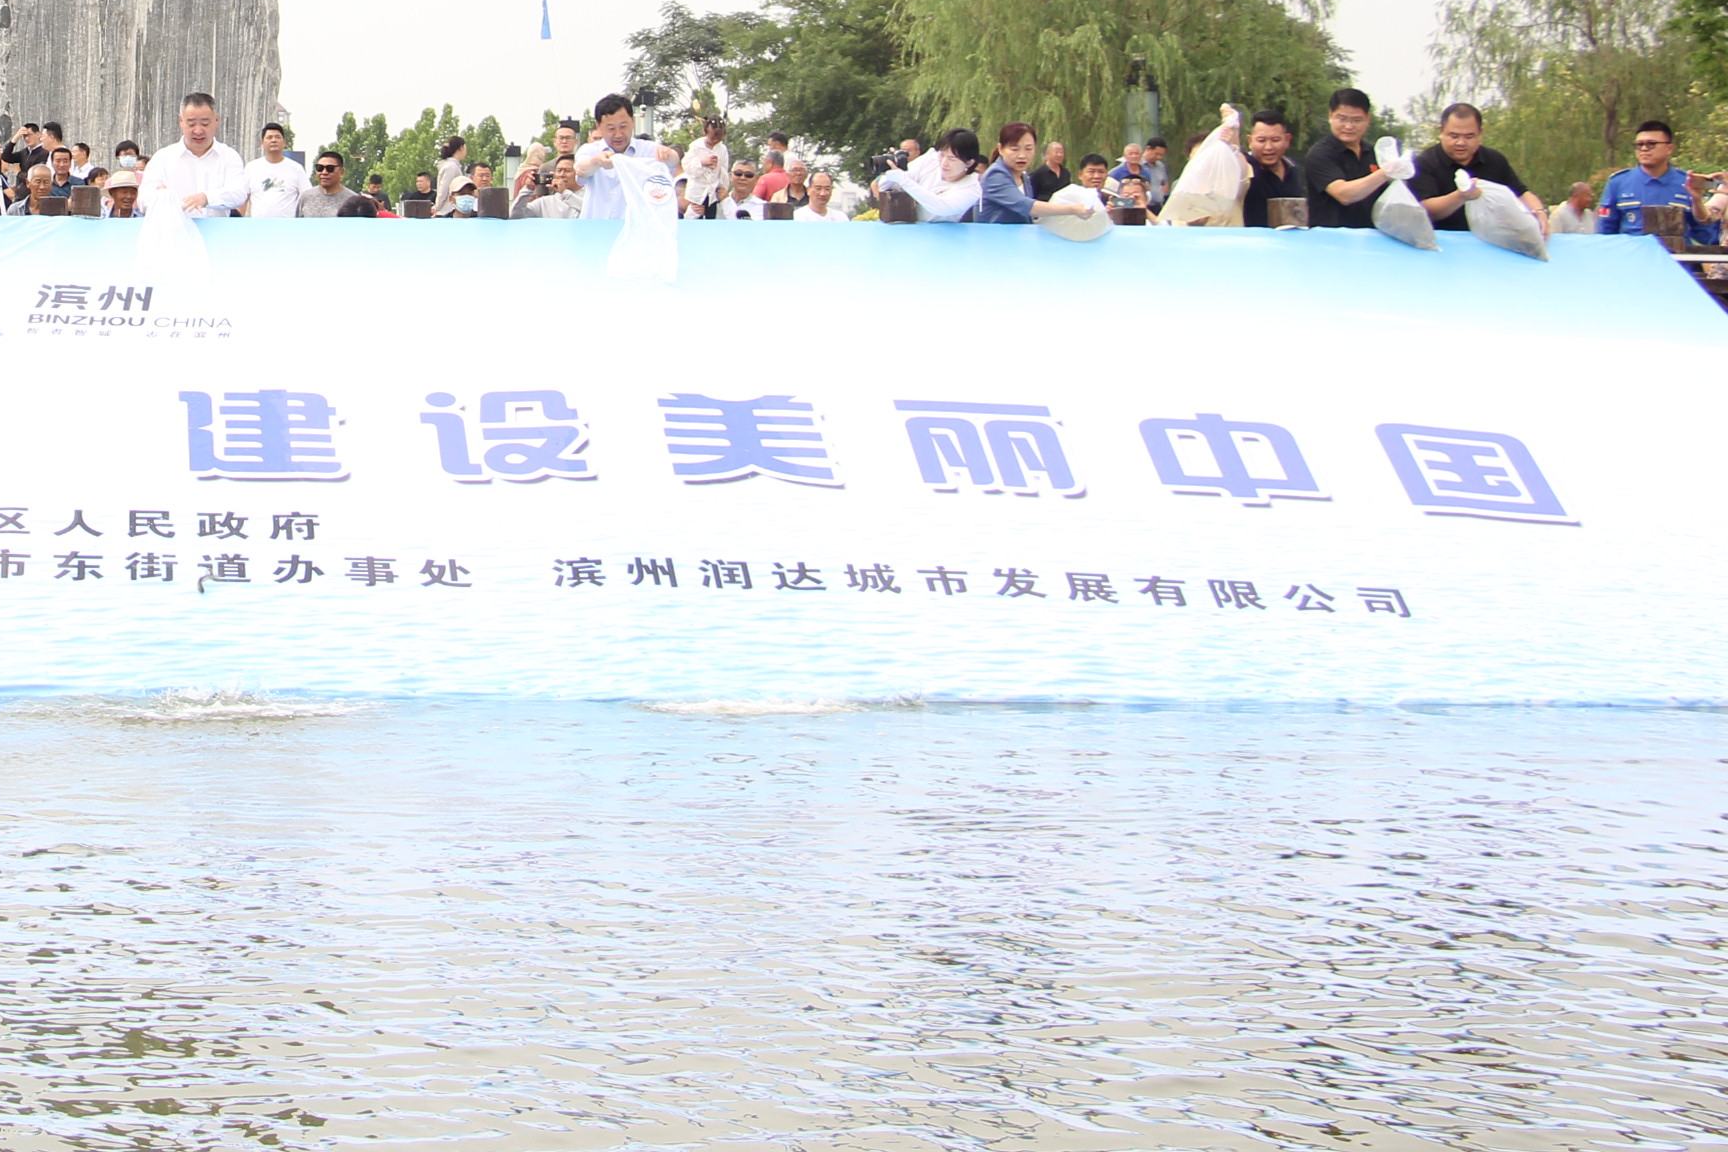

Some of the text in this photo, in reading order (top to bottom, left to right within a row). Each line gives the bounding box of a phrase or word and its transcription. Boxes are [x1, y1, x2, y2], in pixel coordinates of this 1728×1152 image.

[34, 284, 154, 312] 滨州
[27, 313, 233, 329] BINZHOU CHINA
[178, 389, 1582, 526] 建设美丽中国
[552, 556, 1412, 619] 滨州润达城市发展有限公司
